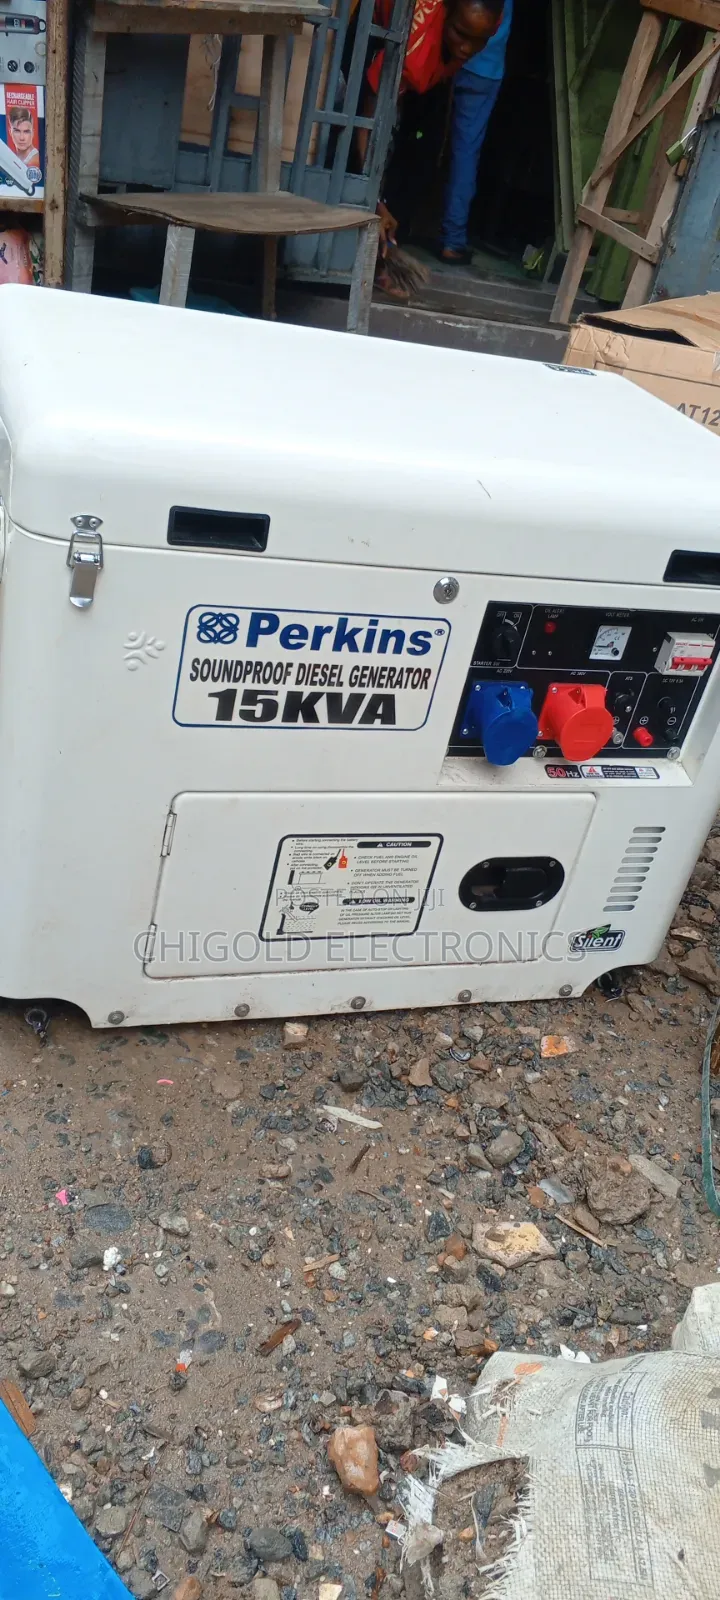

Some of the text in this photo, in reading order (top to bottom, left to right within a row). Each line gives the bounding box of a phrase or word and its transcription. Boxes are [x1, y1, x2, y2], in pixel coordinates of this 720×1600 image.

[245, 612, 432, 656] Perkins
[189, 657, 432, 690] SOUNDPROOF DIESEL GENERATOR
[207, 688, 397, 726] 15KVA
[573, 933, 622, 948] Silent
